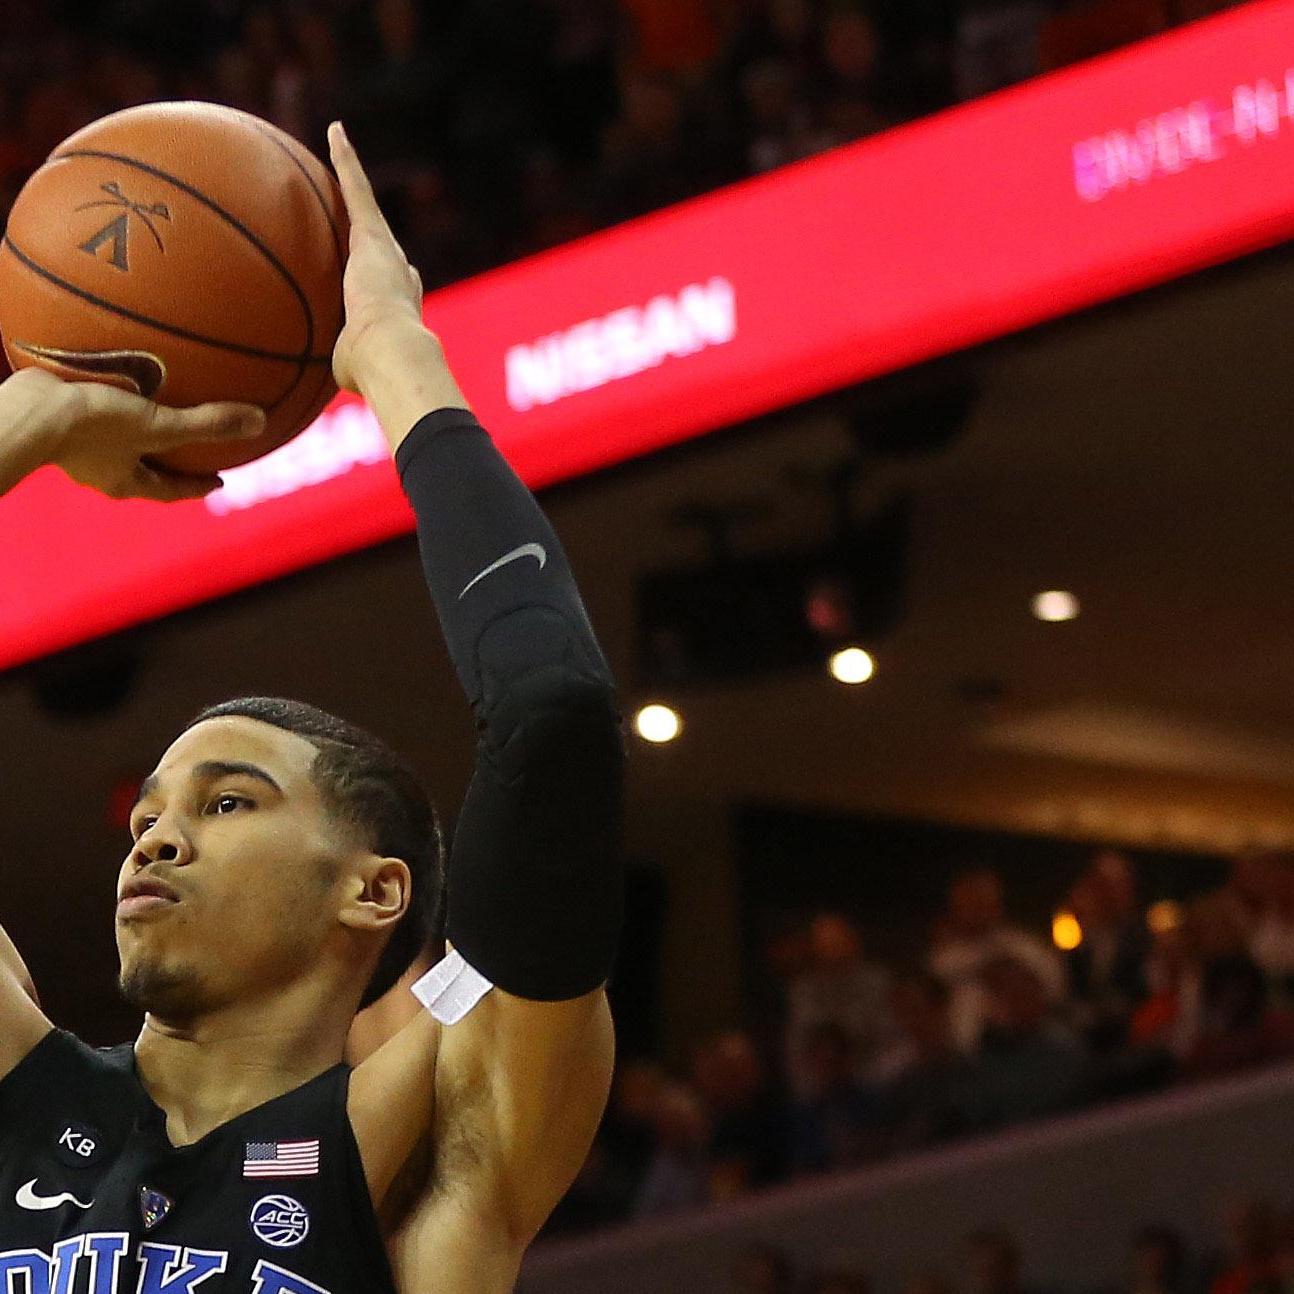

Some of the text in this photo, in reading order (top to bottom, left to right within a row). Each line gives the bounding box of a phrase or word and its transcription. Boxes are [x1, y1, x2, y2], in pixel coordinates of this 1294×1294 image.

[505, 276, 737, 412] NISSAN
[59, 1127, 96, 1157] KB
[258, 1208, 307, 1226] ACC
